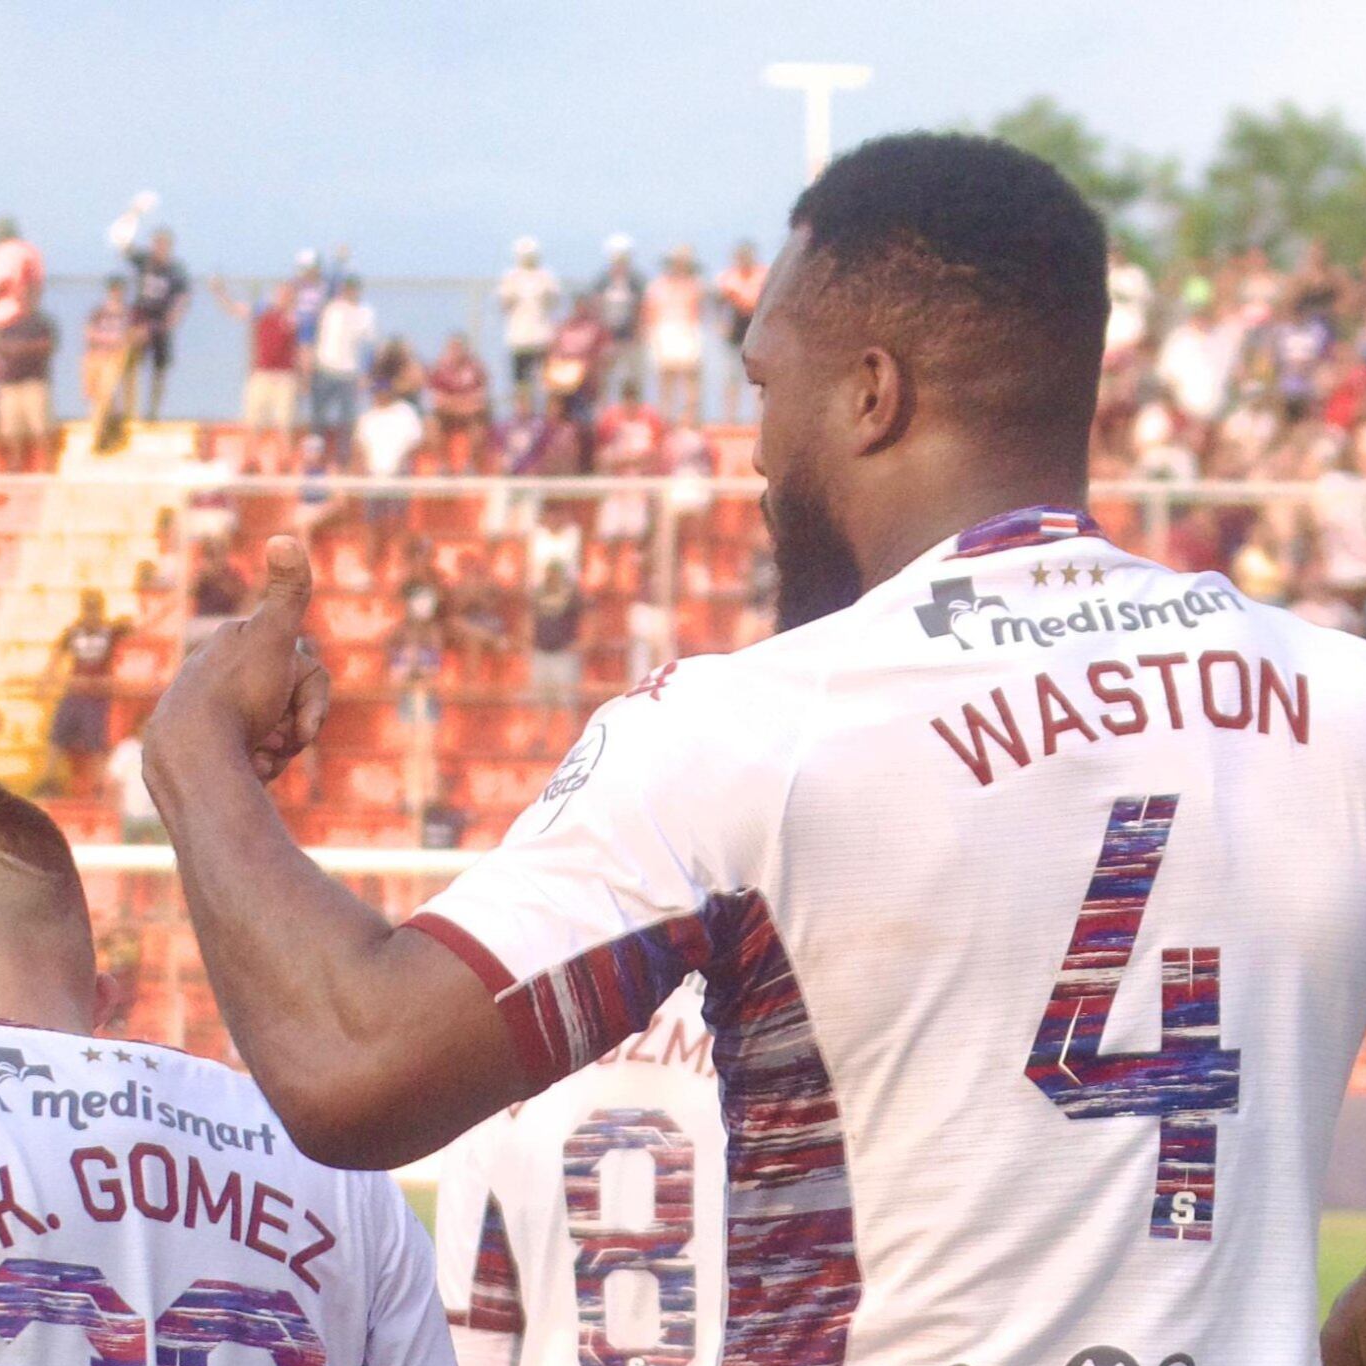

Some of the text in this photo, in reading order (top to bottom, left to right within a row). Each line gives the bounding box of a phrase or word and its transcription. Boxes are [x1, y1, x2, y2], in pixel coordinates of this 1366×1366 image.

[930, 649, 1311, 787] WASTON
[1023, 793, 1242, 1242] 4
[31, 1080, 276, 1156] medismart
[69, 1141, 336, 1295] GOMEZ
[1169, 1191, 1197, 1224] S
